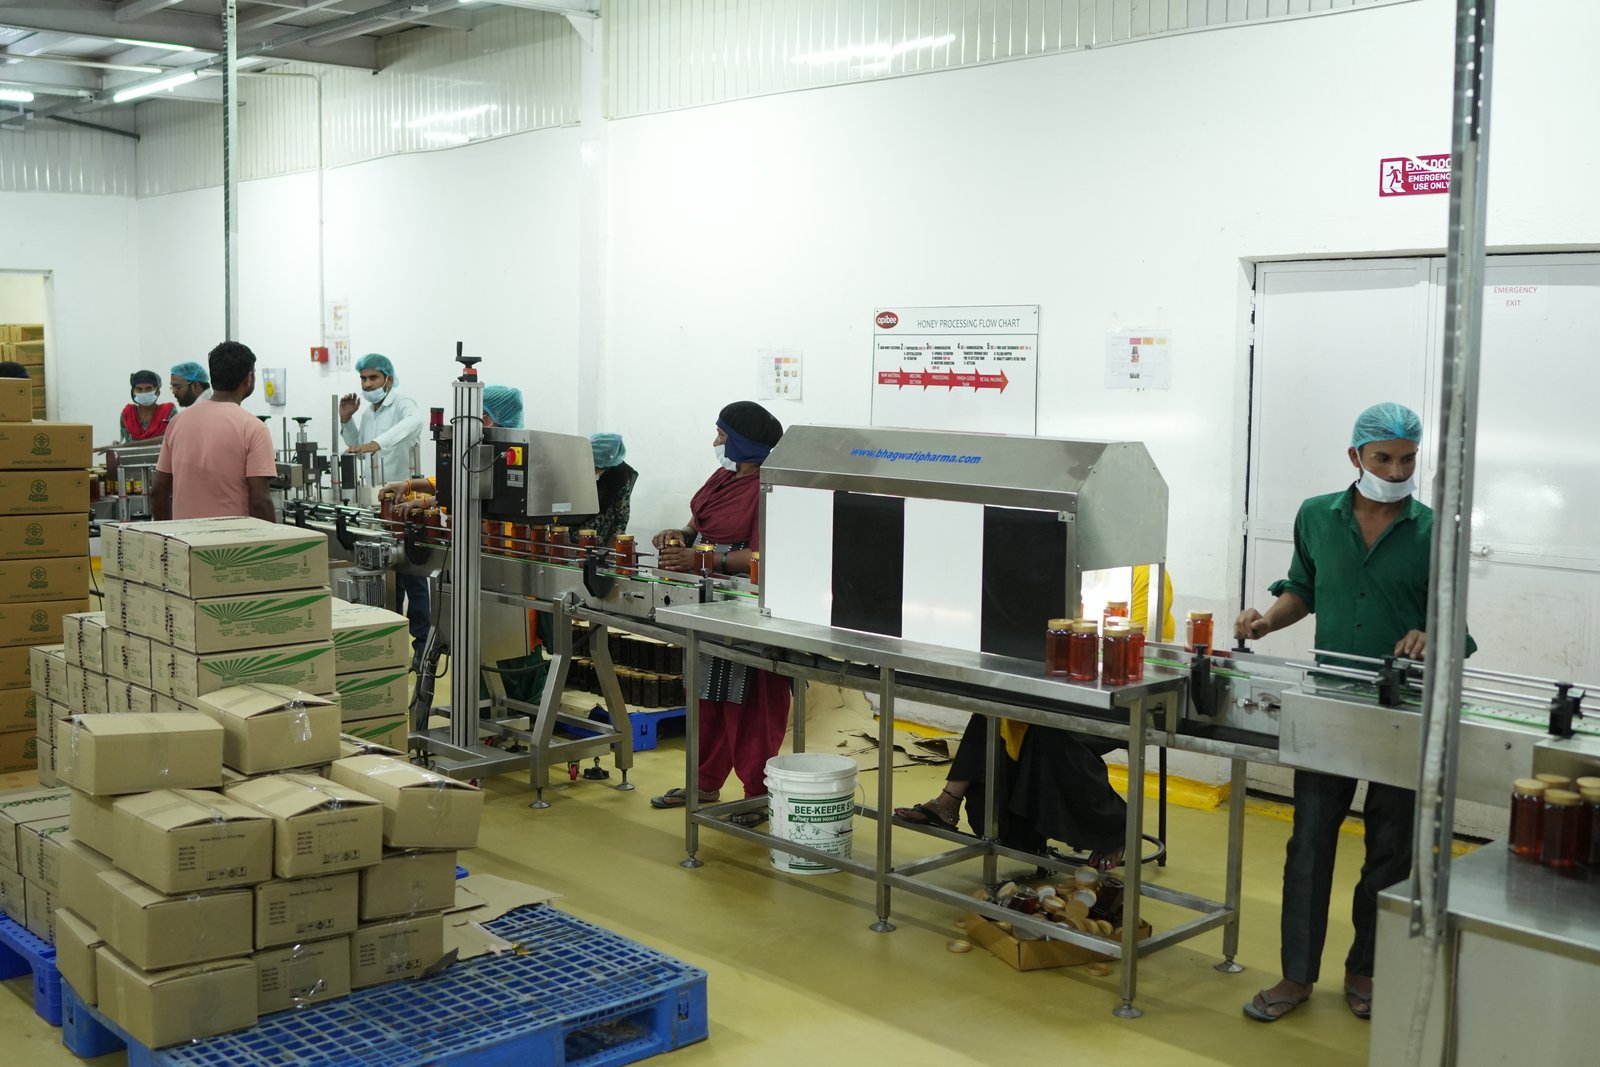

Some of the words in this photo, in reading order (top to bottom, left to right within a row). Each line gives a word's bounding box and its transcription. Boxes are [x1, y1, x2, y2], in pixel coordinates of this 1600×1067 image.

[1430, 158, 1451, 168] DOO
[1408, 173, 1451, 182] EMERGENC
[1413, 182, 1428, 190] USE
[1430, 181, 1451, 190] ONLY
[876, 315, 897, 325] apibee
[918, 320, 938, 328] HONEY
[940, 319, 978, 328] PROCESSING
[978, 319, 998, 328] FLOW
[998, 318, 1020, 328] CHART
[850, 448, 982, 464] www.bhagwatipharma.com
